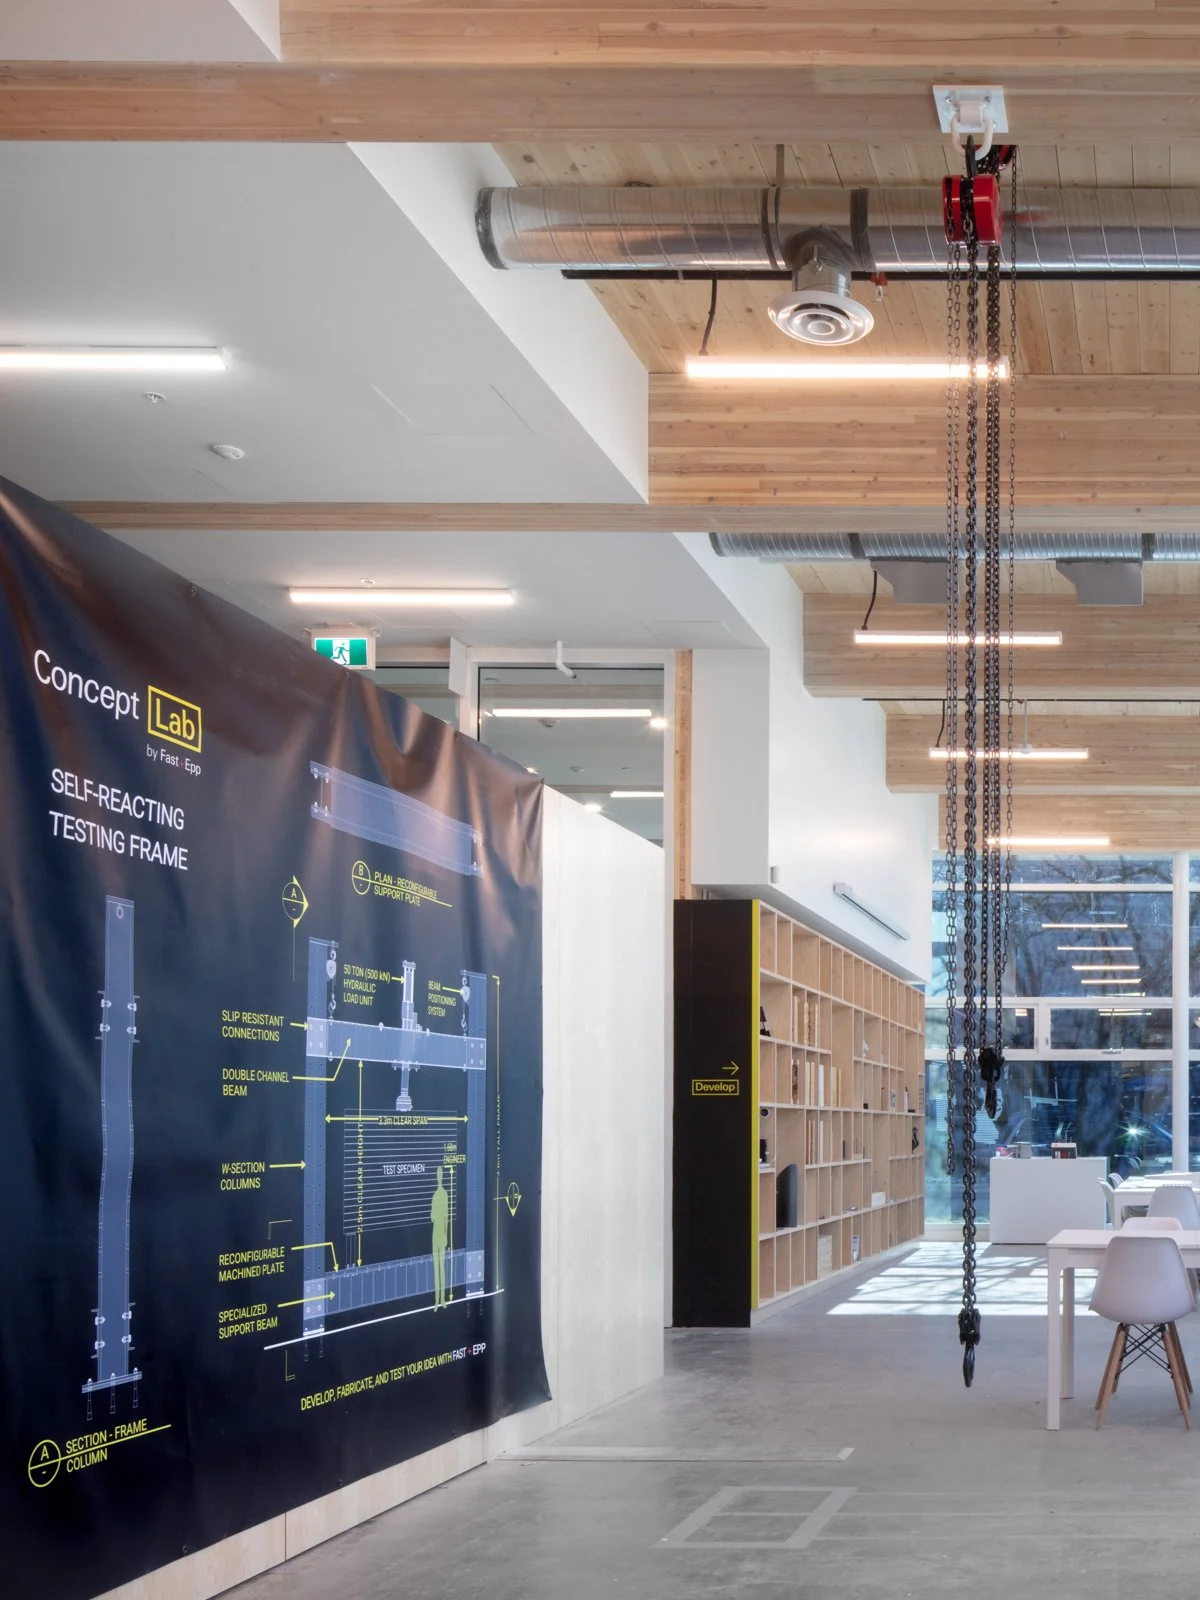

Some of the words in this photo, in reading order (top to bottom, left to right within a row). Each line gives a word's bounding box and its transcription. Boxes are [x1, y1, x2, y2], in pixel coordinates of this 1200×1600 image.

[34, 649, 140, 720] Concept
[155, 697, 195, 741] Lab
[146, 743, 159, 762] by
[50, 768, 185, 830] SELF-REACTING
[48, 810, 125, 854] TESTING
[129, 834, 189, 871] FRAME
[358, 864, 364, 876] B
[291, 887, 297, 899] A
[374, 871, 393, 885] PLAN
[397, 877, 438, 900] RECONFIGURABLE
[374, 885, 404, 901] SUPPORT
[405, 892, 421, 907] PLATE
[343, 963, 352, 975] 50
[352, 965, 364, 977] TON
[364, 968, 379, 981] (500
[379, 970, 391, 984] kN)
[343, 978, 377, 994] HYDRAULIC
[428, 979, 441, 992] BEAM
[343, 992, 359, 1004] LOAD
[359, 994, 374, 1007] UNIT
[428, 992, 457, 1007] POSITIONING
[221, 1009, 240, 1023] SLIP
[241, 1011, 285, 1028] RESISTANT
[427, 1005, 446, 1017] SYSTEM
[222, 1025, 280, 1042] CONNECTIONS
[222, 1068, 256, 1081] DOUBLE
[256, 1070, 290, 1083] CHANNEL
[222, 1084, 248, 1097] BEAM
[695, 1082, 736, 1093] Develop
[394, 1115, 411, 1126] CLEAR
[412, 1115, 428, 1126] SPAN
[443, 1154, 467, 1165] ENGINEER
[221, 1161, 266, 1175] W-SECTION
[382, 1164, 397, 1175] TEST
[397, 1163, 426, 1174] SPECIMEN
[220, 1177, 261, 1191] COLUMNS
[218, 1246, 285, 1266] RECONFIGURABLE
[218, 1265, 261, 1282] MACHINED
[261, 1261, 285, 1276] PLATE
[218, 1303, 268, 1323] SPECIALIZED
[218, 1320, 255, 1340] SUPPORT
[256, 1316, 278, 1331] BEAM
[300, 1388, 336, 1412] DEVELOP,
[336, 1376, 375, 1400] FABRICATE,
[374, 1371, 389, 1386] AND
[389, 1365, 406, 1381] TEST
[405, 1360, 424, 1376] YOUR
[423, 1356, 438, 1371] IDEA
[436, 1351, 453, 1366] WITH
[452, 1346, 467, 1362] FAST
[472, 1342, 487, 1356] EPP
[65, 1429, 107, 1454] SECTION
[114, 1418, 148, 1439] FRAME
[40, 1445, 50, 1461] A
[66, 1447, 108, 1473] COLUMN
